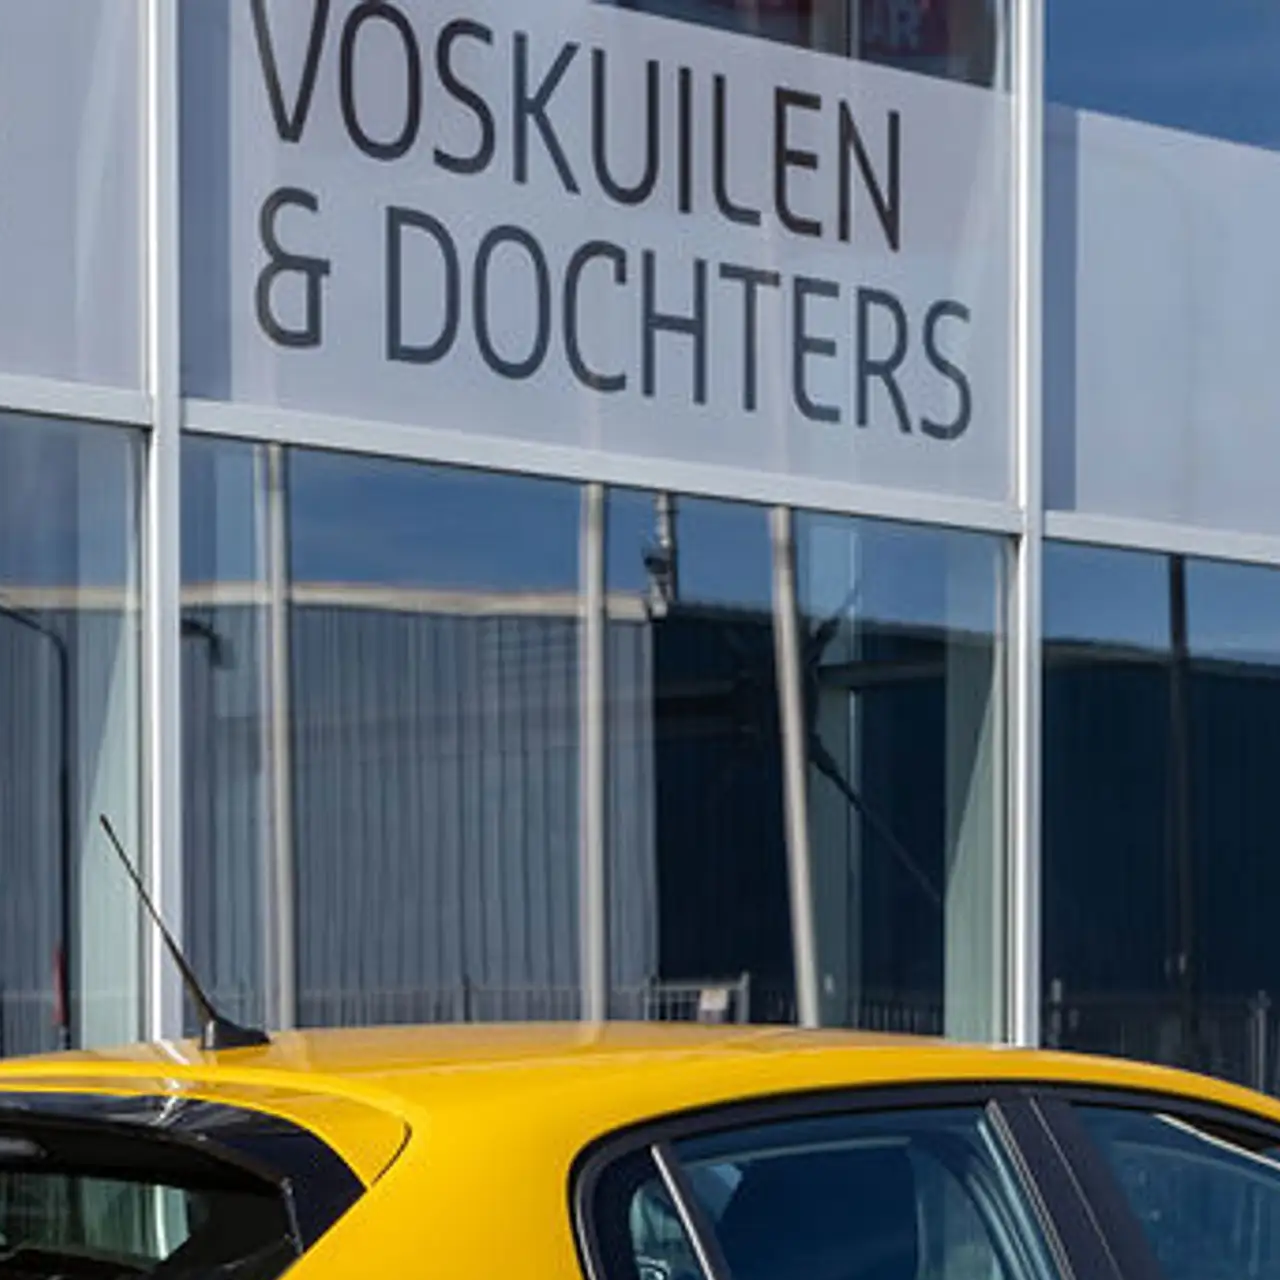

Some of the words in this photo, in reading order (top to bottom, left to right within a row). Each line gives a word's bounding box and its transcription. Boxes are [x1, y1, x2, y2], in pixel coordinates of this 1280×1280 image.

[250, 0, 902, 252] VOSKUILEN
[255, 187, 331, 349] &
[386, 206, 972, 441] DOCHTERS
